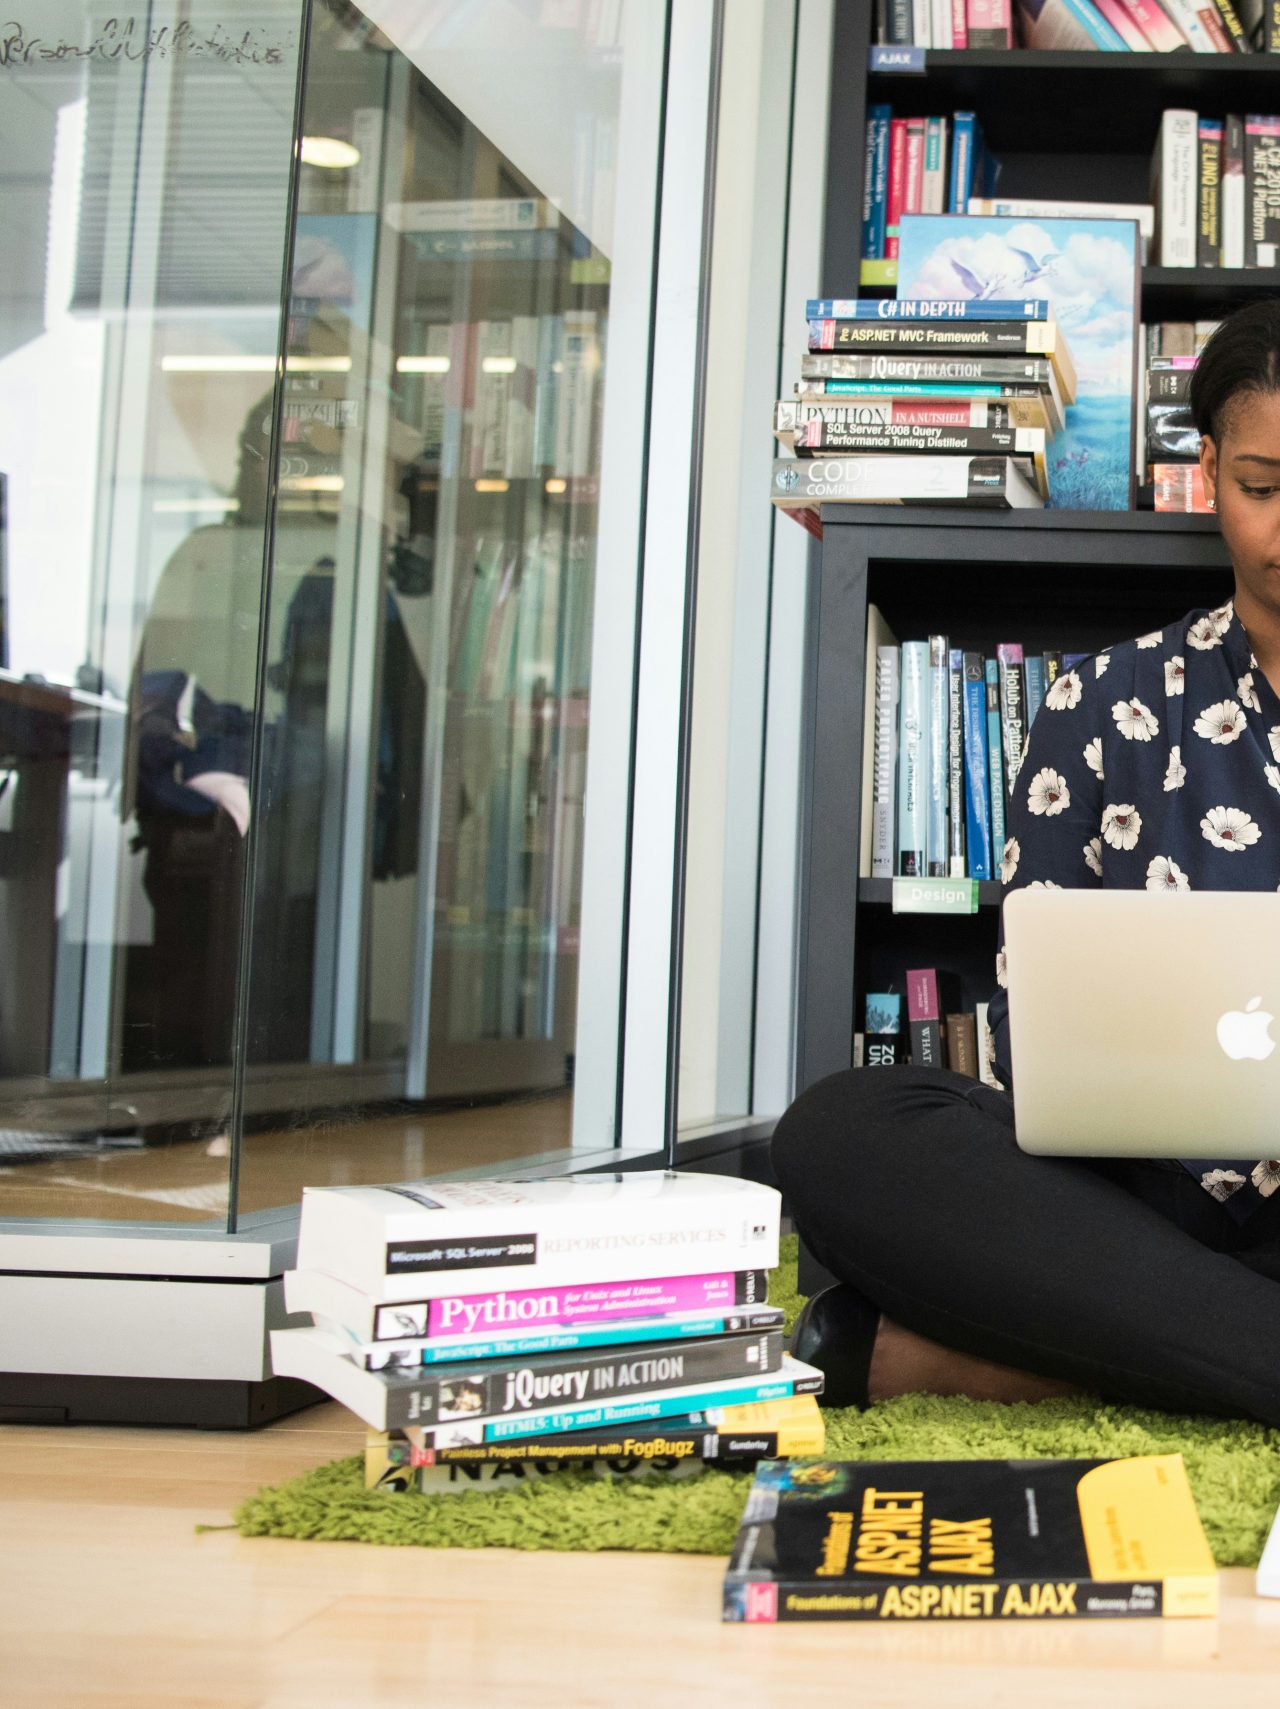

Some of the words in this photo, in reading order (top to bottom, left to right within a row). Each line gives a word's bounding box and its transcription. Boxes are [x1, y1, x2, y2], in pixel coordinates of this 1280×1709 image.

[878, 53, 911, 64] AJAX
[1201, 153, 1218, 186] LINQ
[1253, 188, 1267, 241] Platform
[877, 300, 898, 318] C#
[899, 300, 917, 317] IN
[918, 300, 967, 318] DEPTH
[851, 329, 896, 343] ASP.NET
[899, 329, 925, 343] MVC
[926, 329, 989, 344] Framework
[869, 358, 922, 380] jQuery
[923, 362, 937, 377] IN
[939, 363, 982, 378] ACTION
[806, 407, 888, 425] PYTHON
[895, 413, 904, 423] IN
[914, 412, 967, 424] NUTSHELL
[826, 424, 848, 435] SQL
[850, 424, 883, 435] Server
[884, 425, 910, 436] 2008
[912, 425, 942, 438] Query
[826, 435, 890, 447] Performance
[891, 436, 925, 448] Tuning
[927, 436, 968, 448] Distilled
[880, 659, 892, 701] PAPER
[951, 674, 961, 692] User
[1006, 668, 1020, 704] Holub
[951, 693, 961, 728] Interface
[1008, 706, 1017, 719] on
[878, 708, 892, 804] PROTOTYPING
[951, 729, 961, 756] Design
[1008, 720, 1024, 773] Patterns
[951, 756, 960, 770] for
[990, 748, 1001, 770] WEB
[951, 770, 962, 821] Programmers
[991, 771, 1002, 799] PAGE
[879, 809, 888, 850] SNYDER
[992, 799, 1003, 837] DESIGN
[911, 888, 966, 904] Design
[921, 1026, 932, 1063] WHAT
[390, 1248, 442, 1263] Microsoft
[445, 1247, 467, 1261] SQL
[468, 1245, 501, 1259] Server
[543, 1234, 642, 1255] REPORTING
[644, 1228, 728, 1248] SERVICES
[440, 1292, 560, 1333] Python
[564, 1290, 581, 1304] for
[582, 1289, 610, 1303] Unix
[612, 1286, 632, 1300] and
[633, 1283, 663, 1298] Linux
[563, 1302, 598, 1318] System
[600, 1294, 677, 1313] Administration
[494, 1341, 516, 1354] The
[517, 1337, 549, 1351] Good
[550, 1335, 579, 1348] Parts
[503, 1367, 590, 1412] jQuery
[594, 1364, 615, 1391] IN
[617, 1356, 685, 1388] ACTION
[552, 1414, 574, 1431] Up
[577, 1410, 601, 1425] and
[603, 1404, 661, 1423] Running
[441, 1447, 487, 1459] Painless
[488, 1446, 526, 1459] Project
[527, 1444, 597, 1458] Management
[598, 1443, 623, 1455] with
[623, 1438, 695, 1459] FogBugz
[854, 1487, 925, 1577] ASP.NET
[928, 1517, 996, 1577] AJAX
[786, 1594, 858, 1611] Foundations
[861, 1592, 878, 1610] of
[880, 1584, 1000, 1618] ASP.NET
[1001, 1583, 1077, 1616] AJAX
